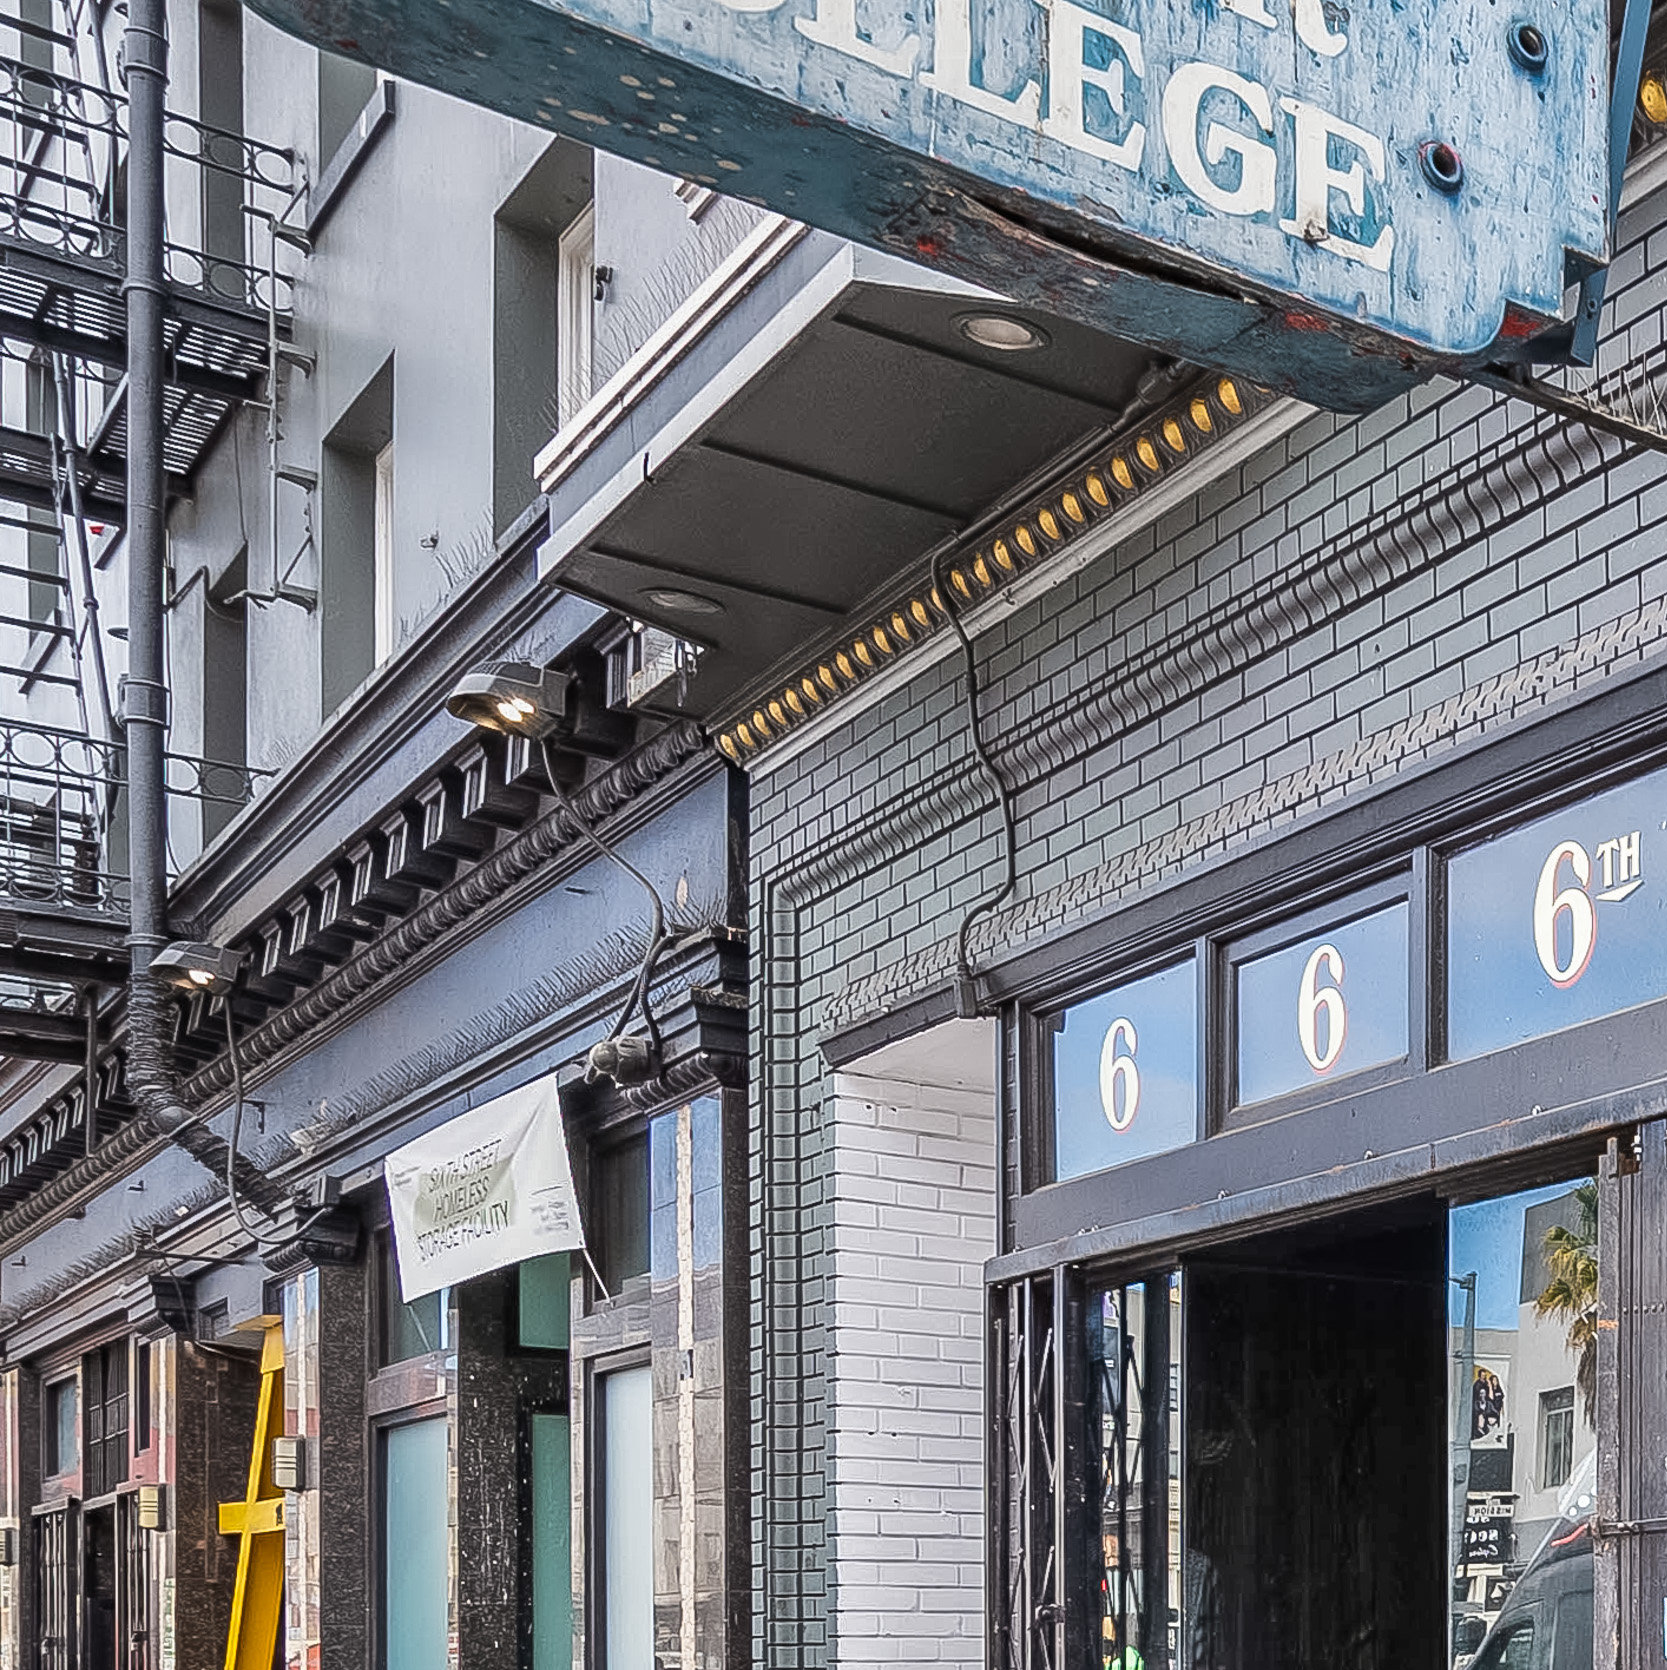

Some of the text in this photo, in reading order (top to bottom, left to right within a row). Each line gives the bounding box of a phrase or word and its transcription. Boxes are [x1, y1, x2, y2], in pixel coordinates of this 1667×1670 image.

[718, 0, 1396, 273] LEGE
[1099, 831, 1642, 1135] 6 6 6TH
